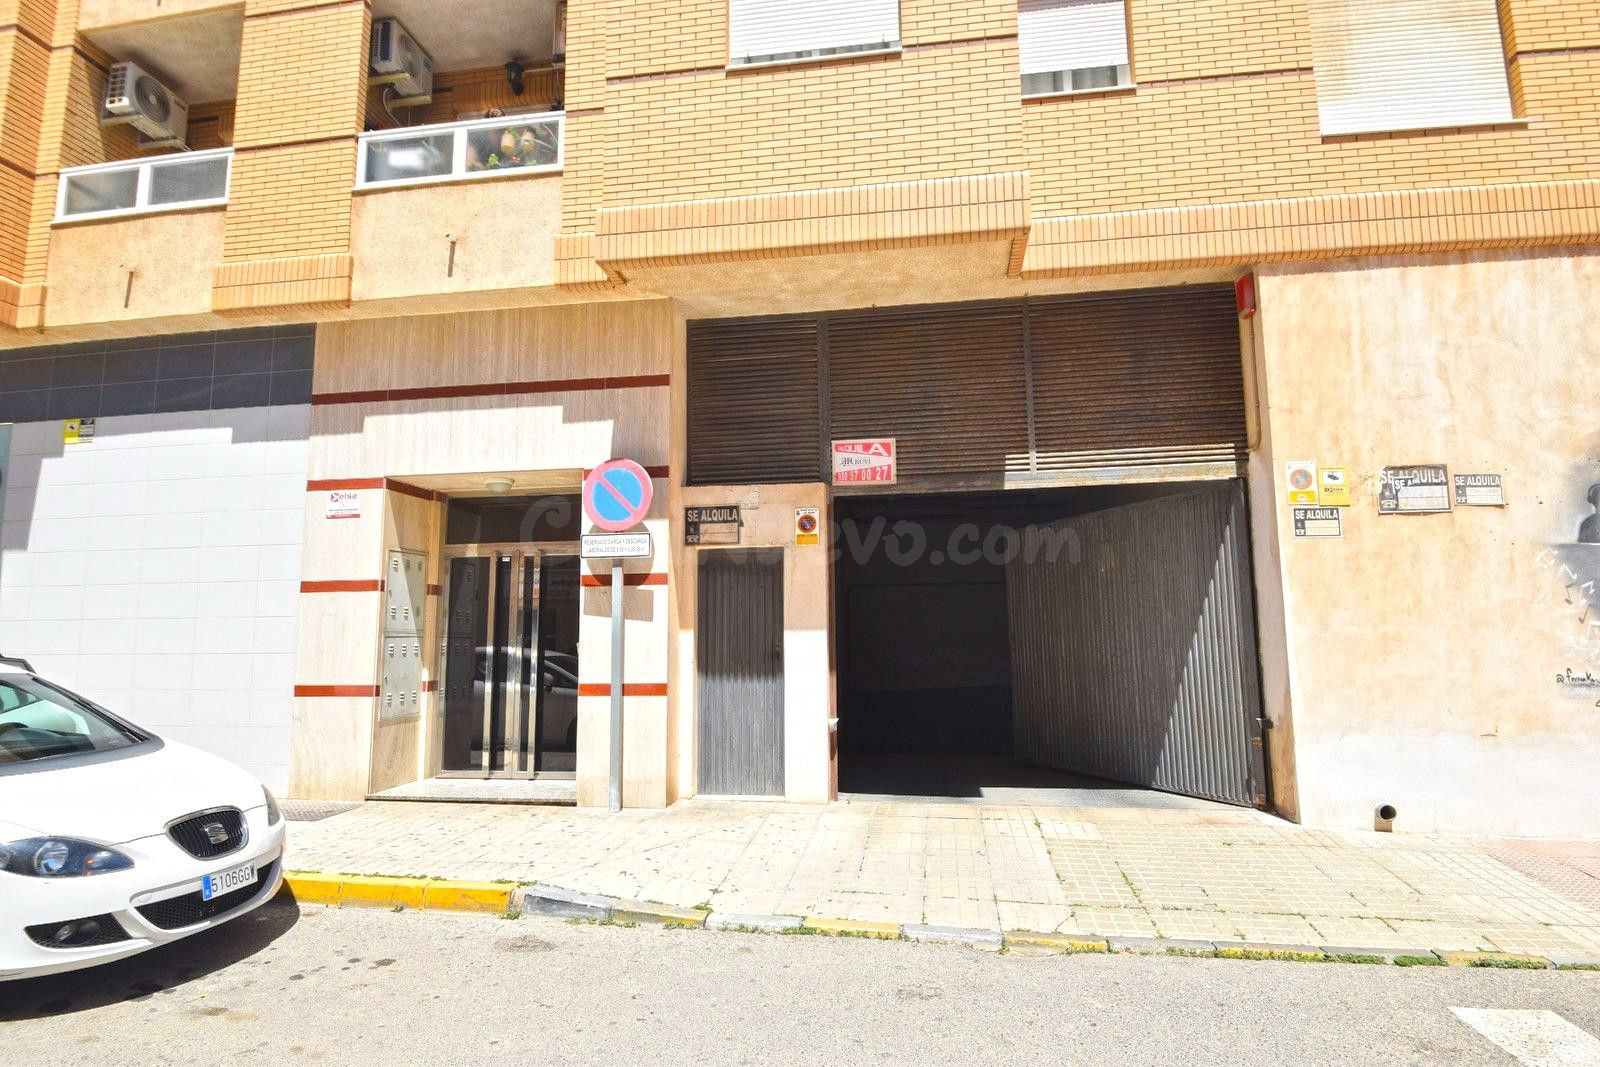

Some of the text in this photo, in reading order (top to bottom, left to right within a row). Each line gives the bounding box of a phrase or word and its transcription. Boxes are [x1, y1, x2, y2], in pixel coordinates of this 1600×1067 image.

[837, 442, 889, 457] ALQUILA
[875, 466, 888, 481] 27
[1381, 470, 1394, 484] SE
[1455, 475, 1501, 486] SE ALQUILA
[687, 508, 738, 522] SE ALQUILA
[1295, 509, 1339, 520] SE ALQUILA
